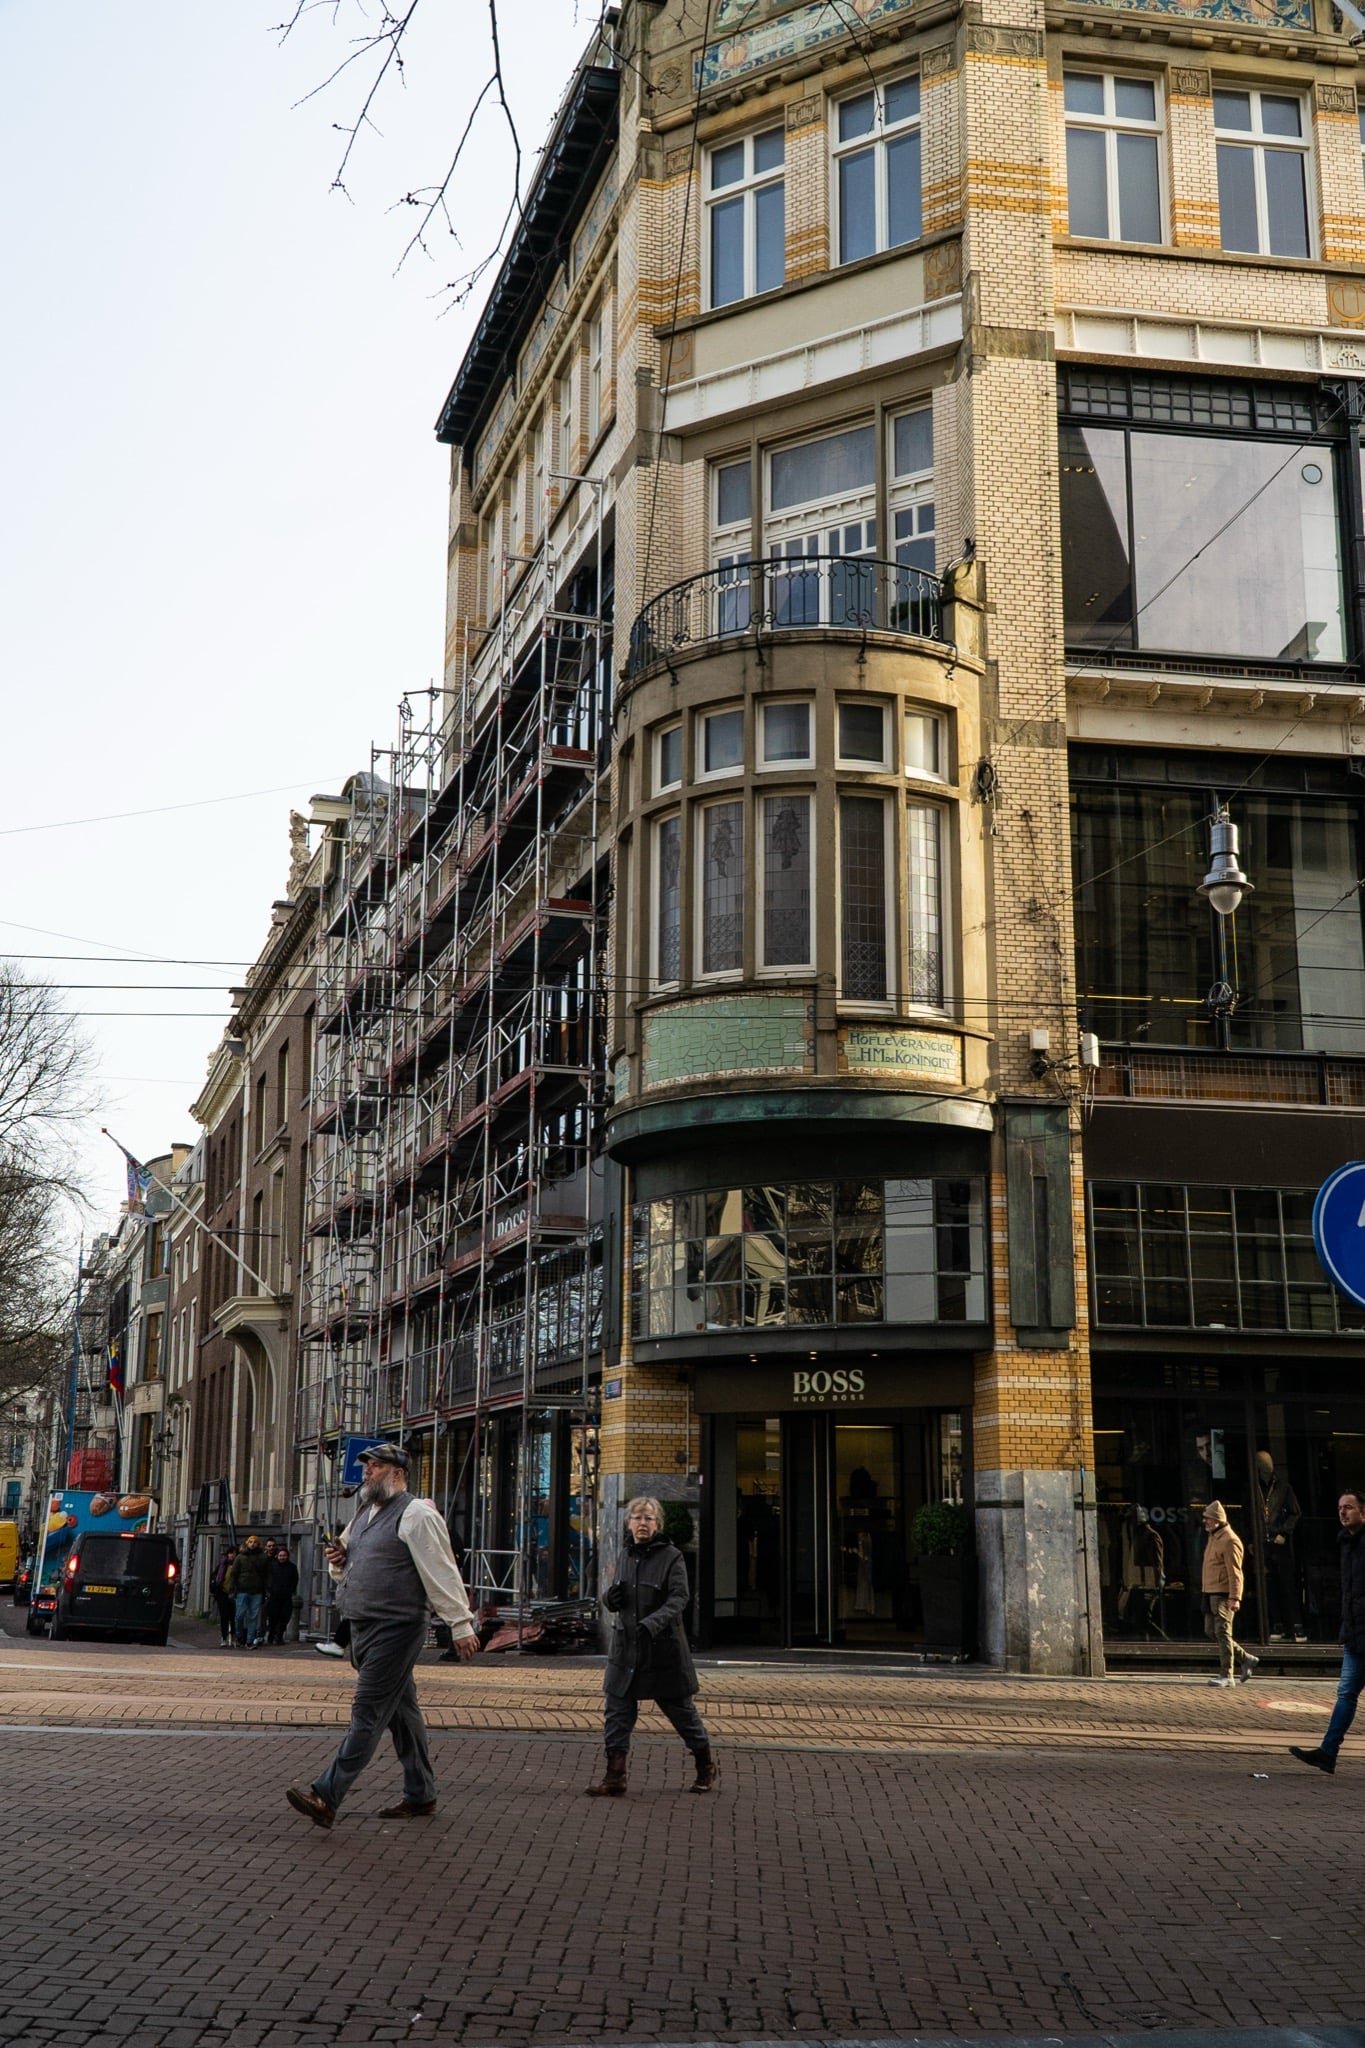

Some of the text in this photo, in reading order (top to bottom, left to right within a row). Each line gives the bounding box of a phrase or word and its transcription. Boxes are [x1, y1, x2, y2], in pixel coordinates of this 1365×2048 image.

[895, 1049, 951, 1069] KONINGIN
[792, 1369, 865, 1394] BOSS
[793, 1394, 865, 1403] HUGO BOSS
